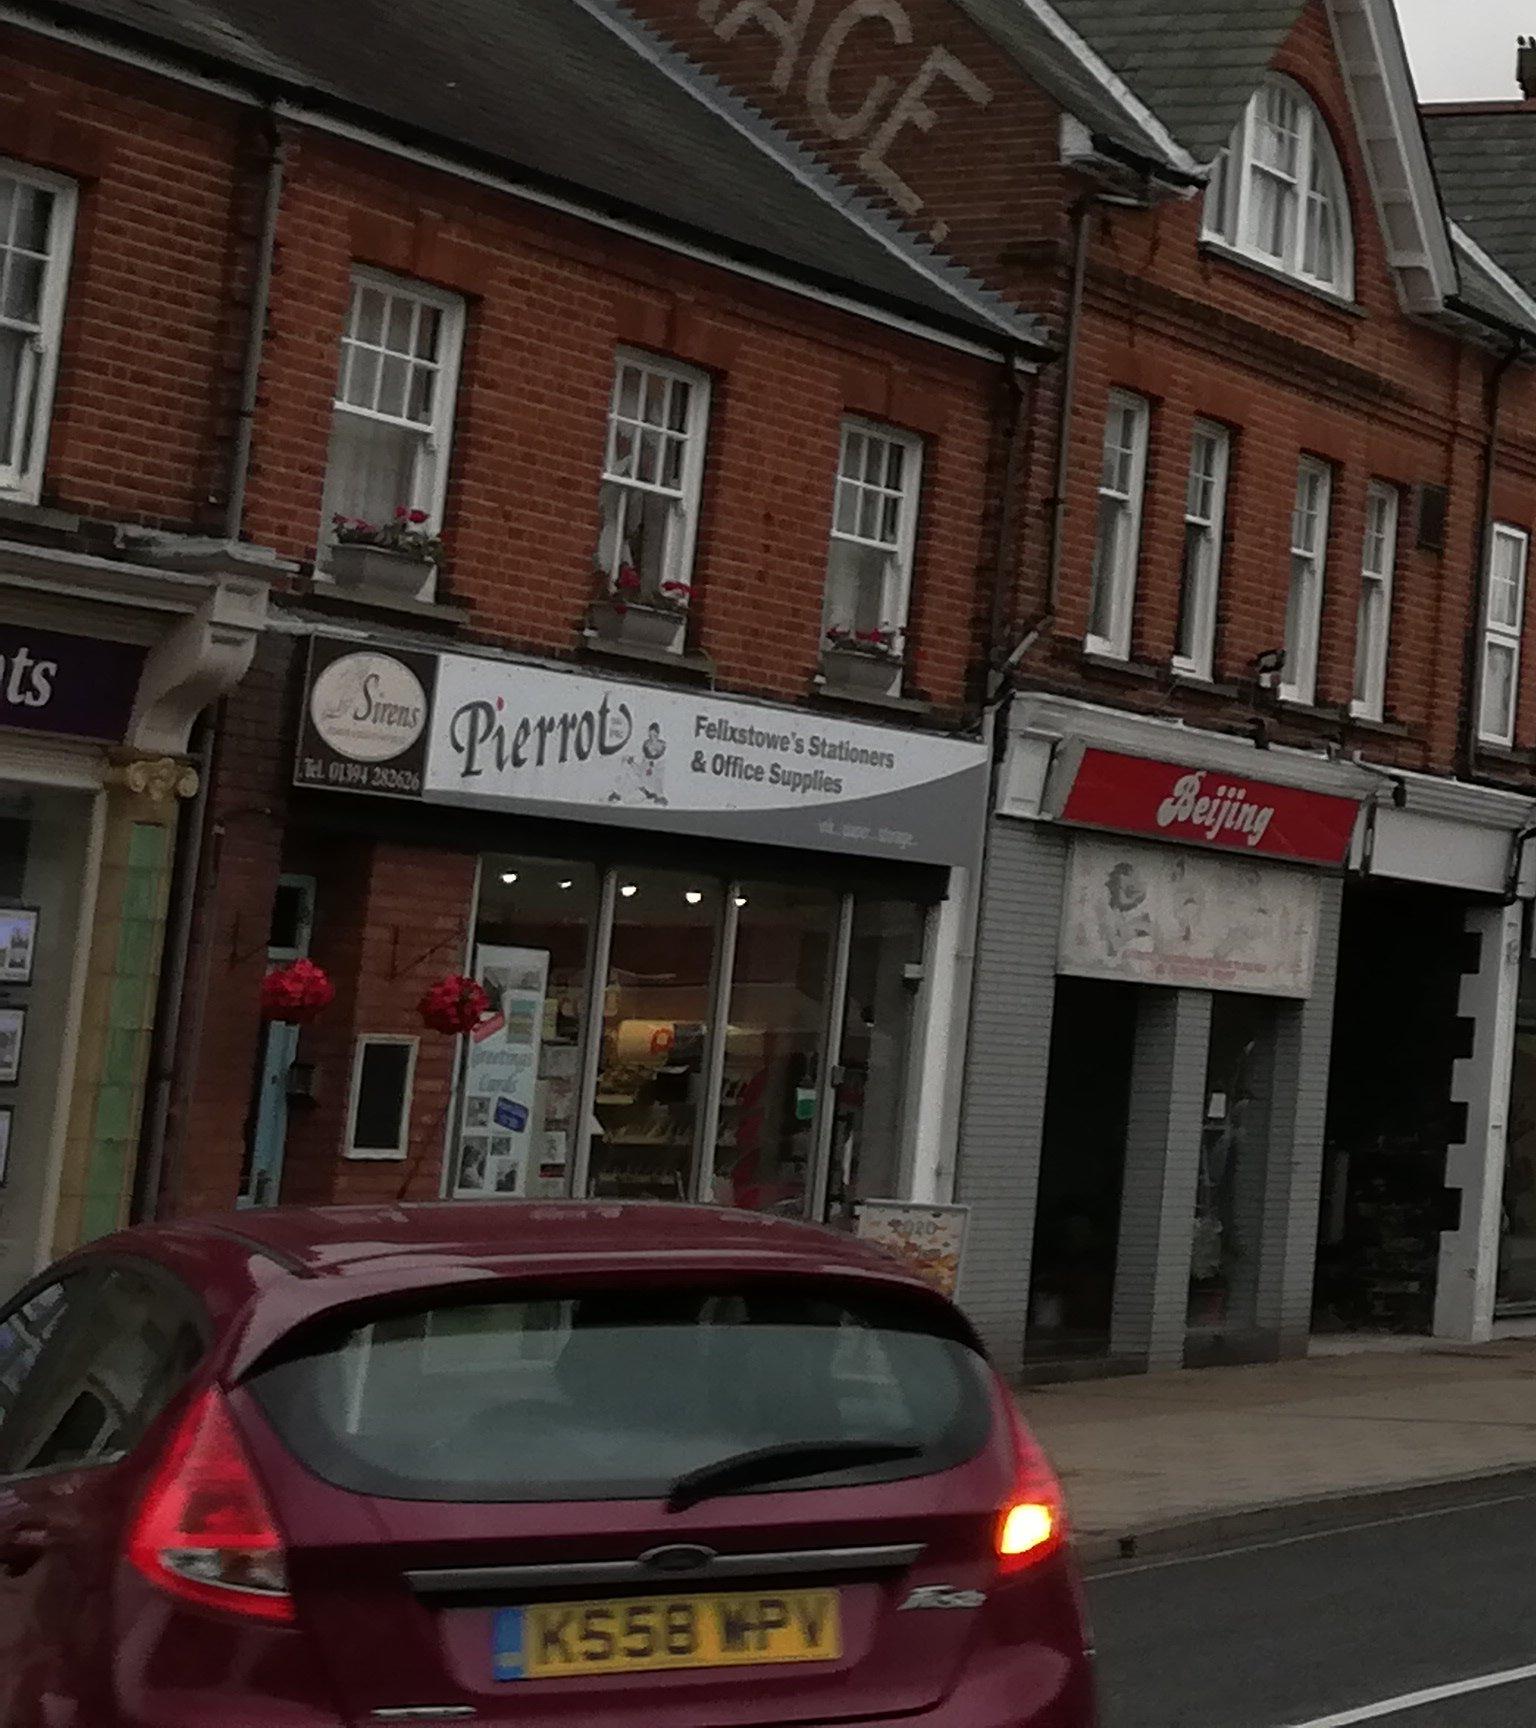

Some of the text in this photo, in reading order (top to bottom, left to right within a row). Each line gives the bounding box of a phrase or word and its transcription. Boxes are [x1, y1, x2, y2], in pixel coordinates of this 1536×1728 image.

[0, 647, 57, 707] ts
[353, 673, 420, 729] Sirens
[451, 690, 632, 778] Pierrot
[694, 715, 895, 769] Felixstowe's Stationers
[690, 750, 843, 795] & Office Supplies
[1156, 771, 1275, 847] Beijing
